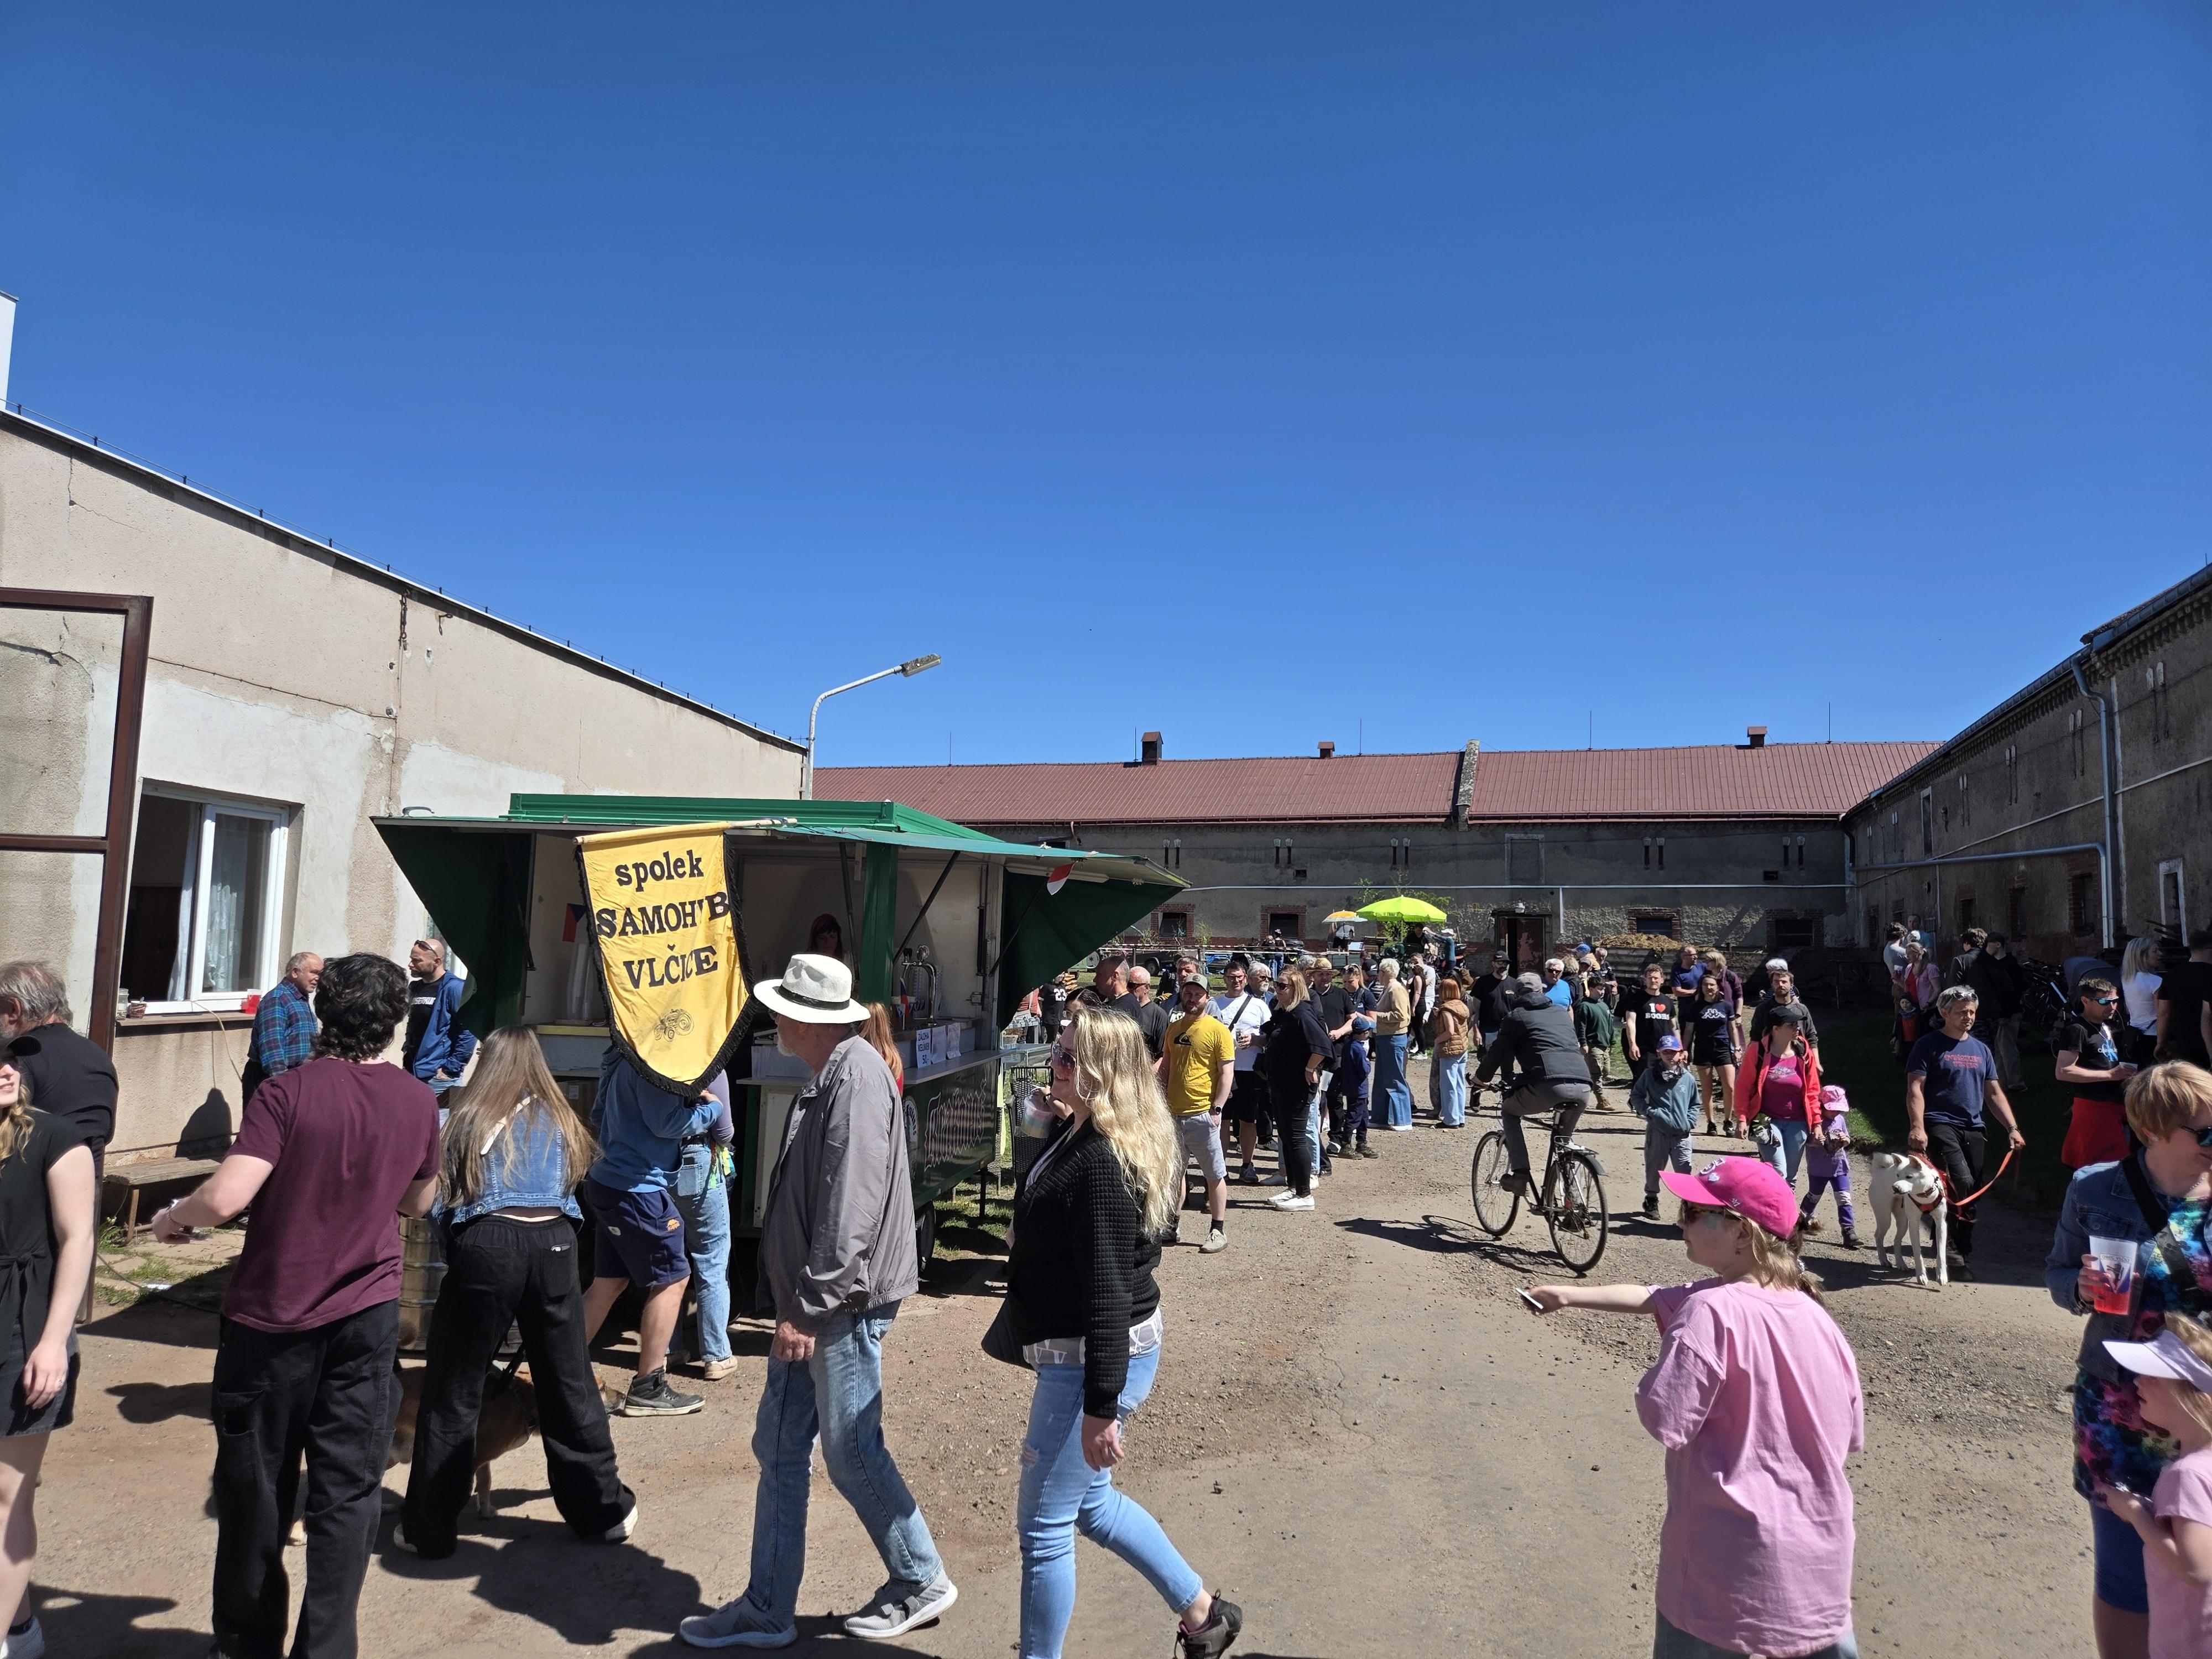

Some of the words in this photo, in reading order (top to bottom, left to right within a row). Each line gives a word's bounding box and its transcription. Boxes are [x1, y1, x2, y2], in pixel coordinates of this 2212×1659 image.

[615, 849, 704, 892] spolek
[623, 944, 718, 989] VLČICE
[1053, 988, 1067, 1001] 23
[1649, 1003, 1656, 1013] I
